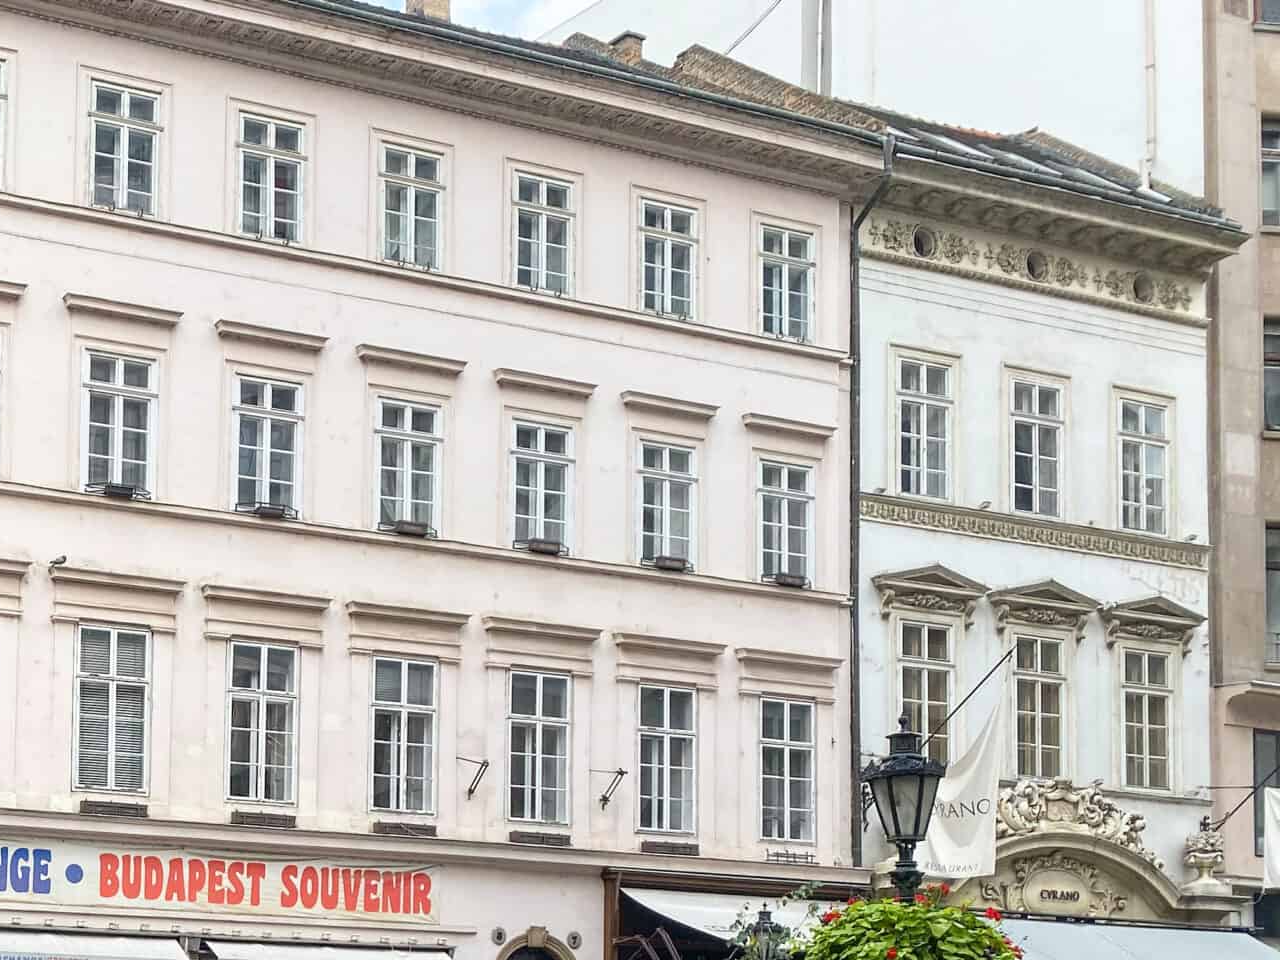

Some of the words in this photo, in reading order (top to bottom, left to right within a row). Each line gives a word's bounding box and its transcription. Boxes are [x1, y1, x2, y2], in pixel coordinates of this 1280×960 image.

[99, 852, 266, 907] BUDAPEST
[280, 864, 432, 915] SOUVENIR
[1039, 889, 1080, 901] CYRANO
